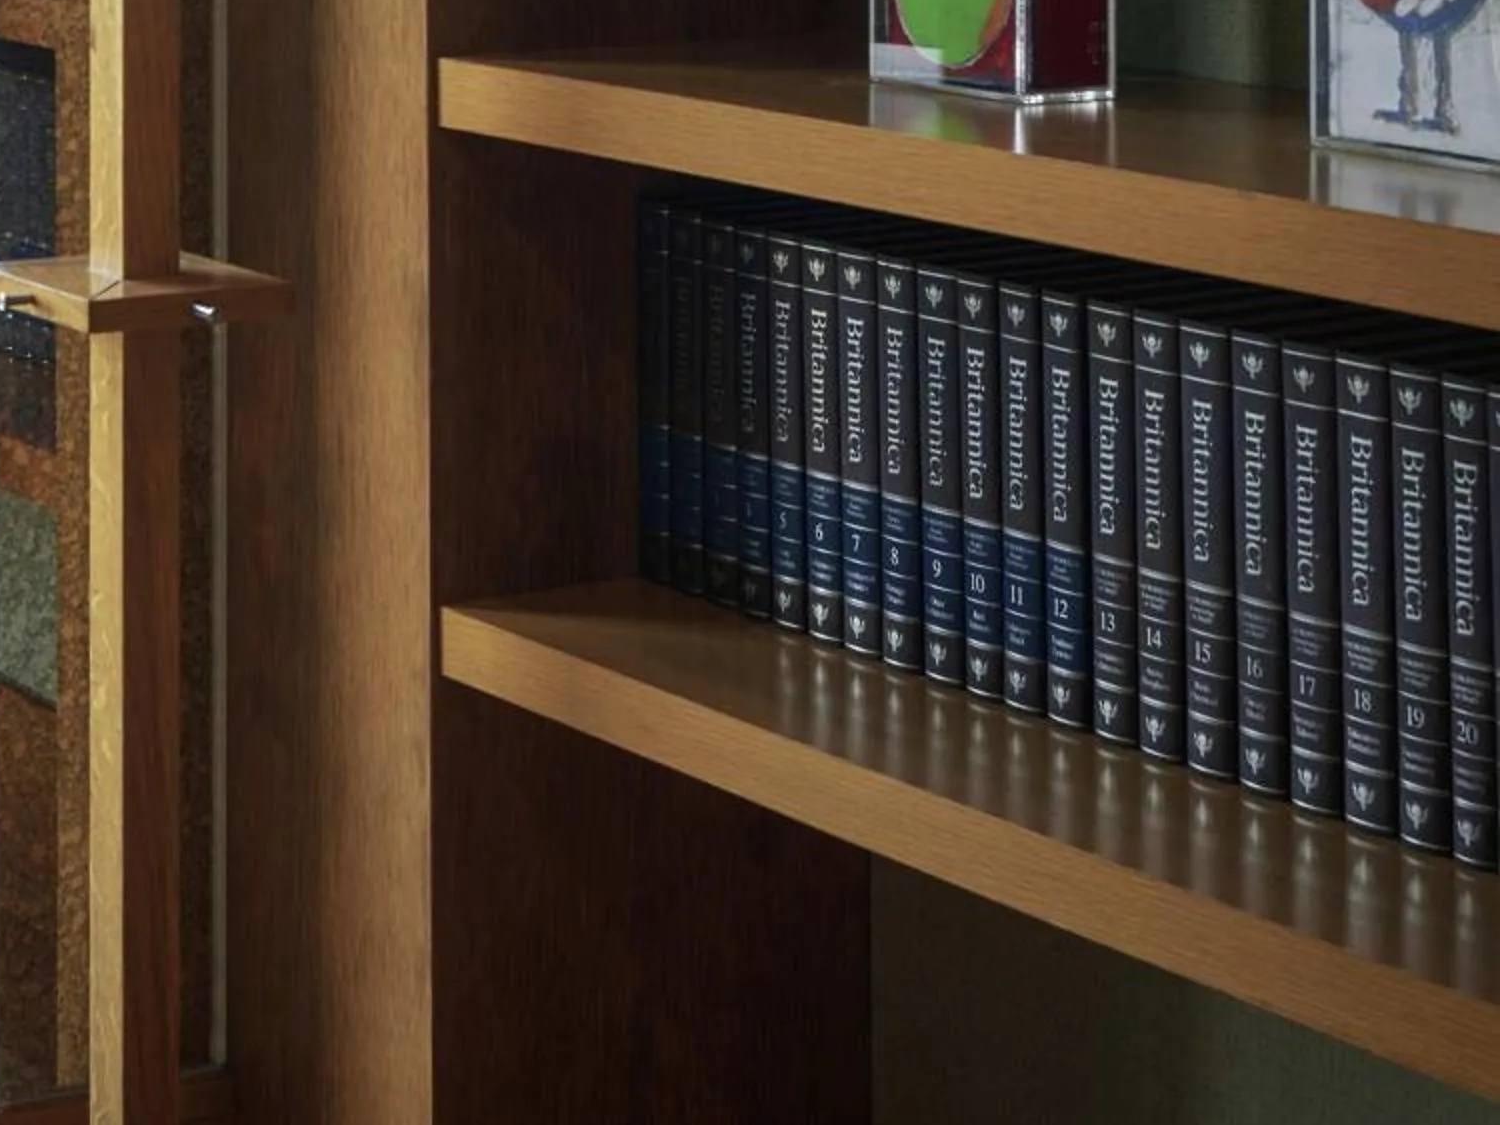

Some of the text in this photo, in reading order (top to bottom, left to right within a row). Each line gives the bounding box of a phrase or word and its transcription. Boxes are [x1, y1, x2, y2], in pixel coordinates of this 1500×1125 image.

[740, 292, 758, 434] Britannica
[775, 299, 793, 443] Britannica
[810, 308, 829, 453] Britannica
[846, 317, 865, 463] Britannica
[886, 326, 904, 475] Britannica
[927, 336, 947, 487] Britannica
[966, 346, 987, 499] Britannica
[1009, 356, 1028, 511] Britannica
[1051, 366, 1072, 522] Britannica
[1099, 376, 1120, 535] Britannica
[1144, 388, 1166, 550] Britannica
[1192, 399, 1214, 562] Britannica
[1244, 410, 1267, 576] Britannica
[1295, 424, 1319, 593] Britannica
[779, 511, 788, 529] 5
[814, 522, 824, 542] 6
[851, 533, 861, 552] 7
[890, 546, 900, 566] 8
[932, 559, 943, 578] 9
[970, 572, 986, 594] 10
[1350, 434, 1374, 606] Britannica
[1401, 447, 1427, 621] Britannica
[1453, 459, 1479, 636] Britannica
[1010, 584, 1024, 606] 11
[1053, 597, 1070, 619] 12
[1100, 611, 1117, 633] 13
[1146, 626, 1163, 650] 14
[1194, 640, 1212, 664] 15
[1246, 656, 1263, 679] 16
[1299, 675, 1316, 697] 17
[1353, 688, 1372, 714] 18
[1406, 704, 1425, 730] 19
[1456, 720, 1479, 745] 20
